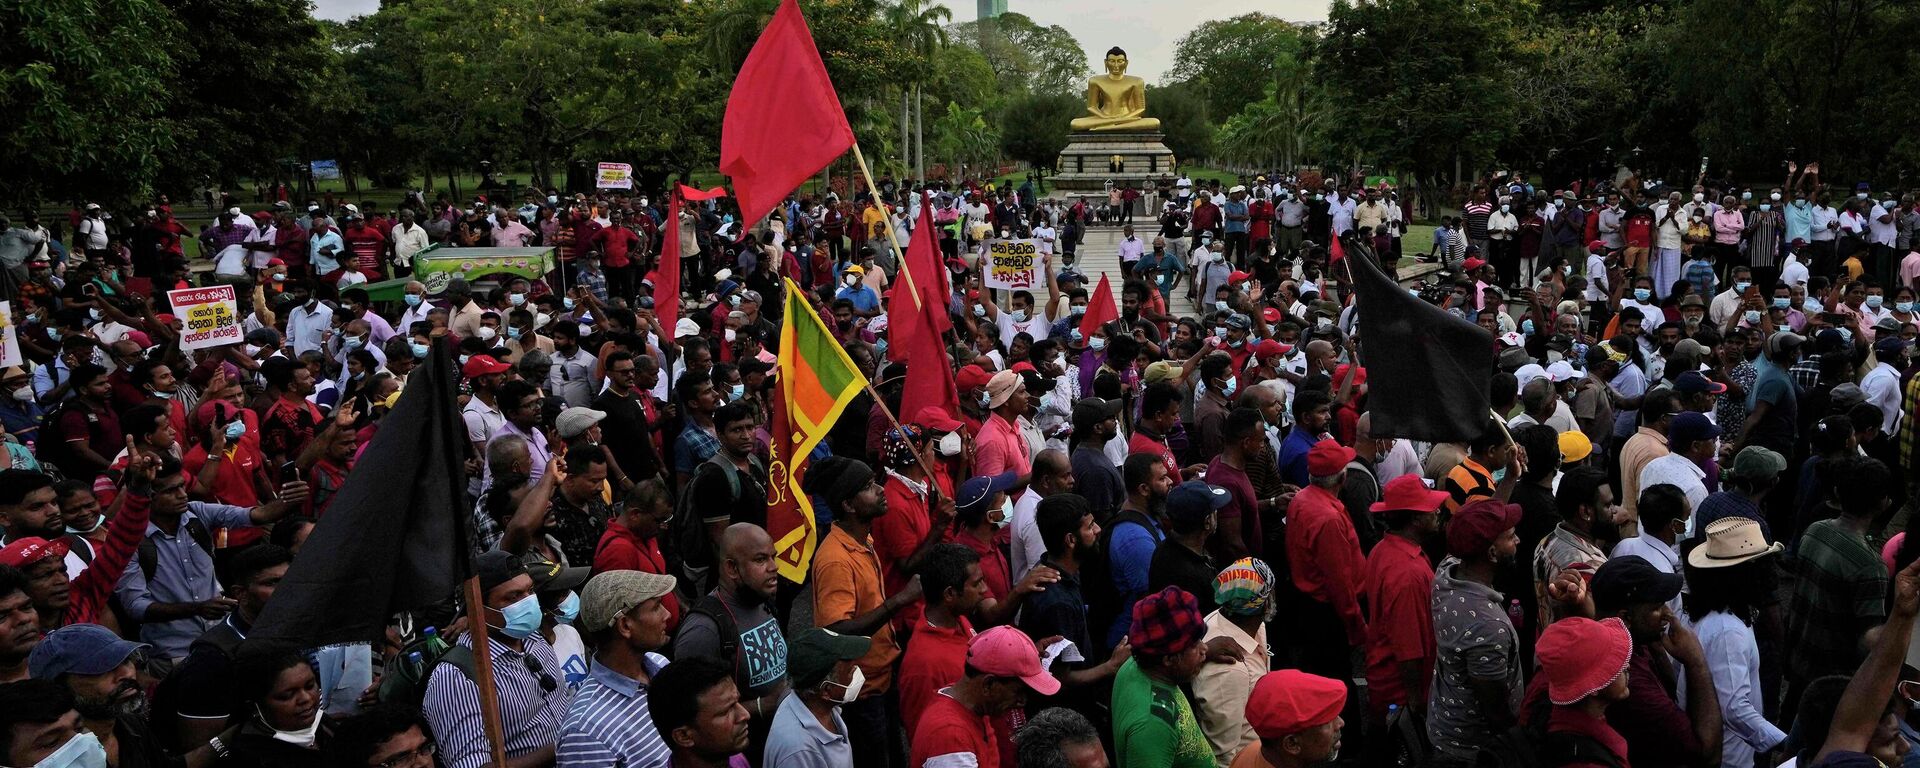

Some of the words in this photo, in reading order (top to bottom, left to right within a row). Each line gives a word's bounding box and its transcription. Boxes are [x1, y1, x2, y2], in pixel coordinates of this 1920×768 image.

[990, 243, 1006, 254] ජන
[993, 255, 1033, 269] ආණ්ඩුව
[188, 319, 213, 330] ජනතා
[750, 671, 772, 685] DENIM
